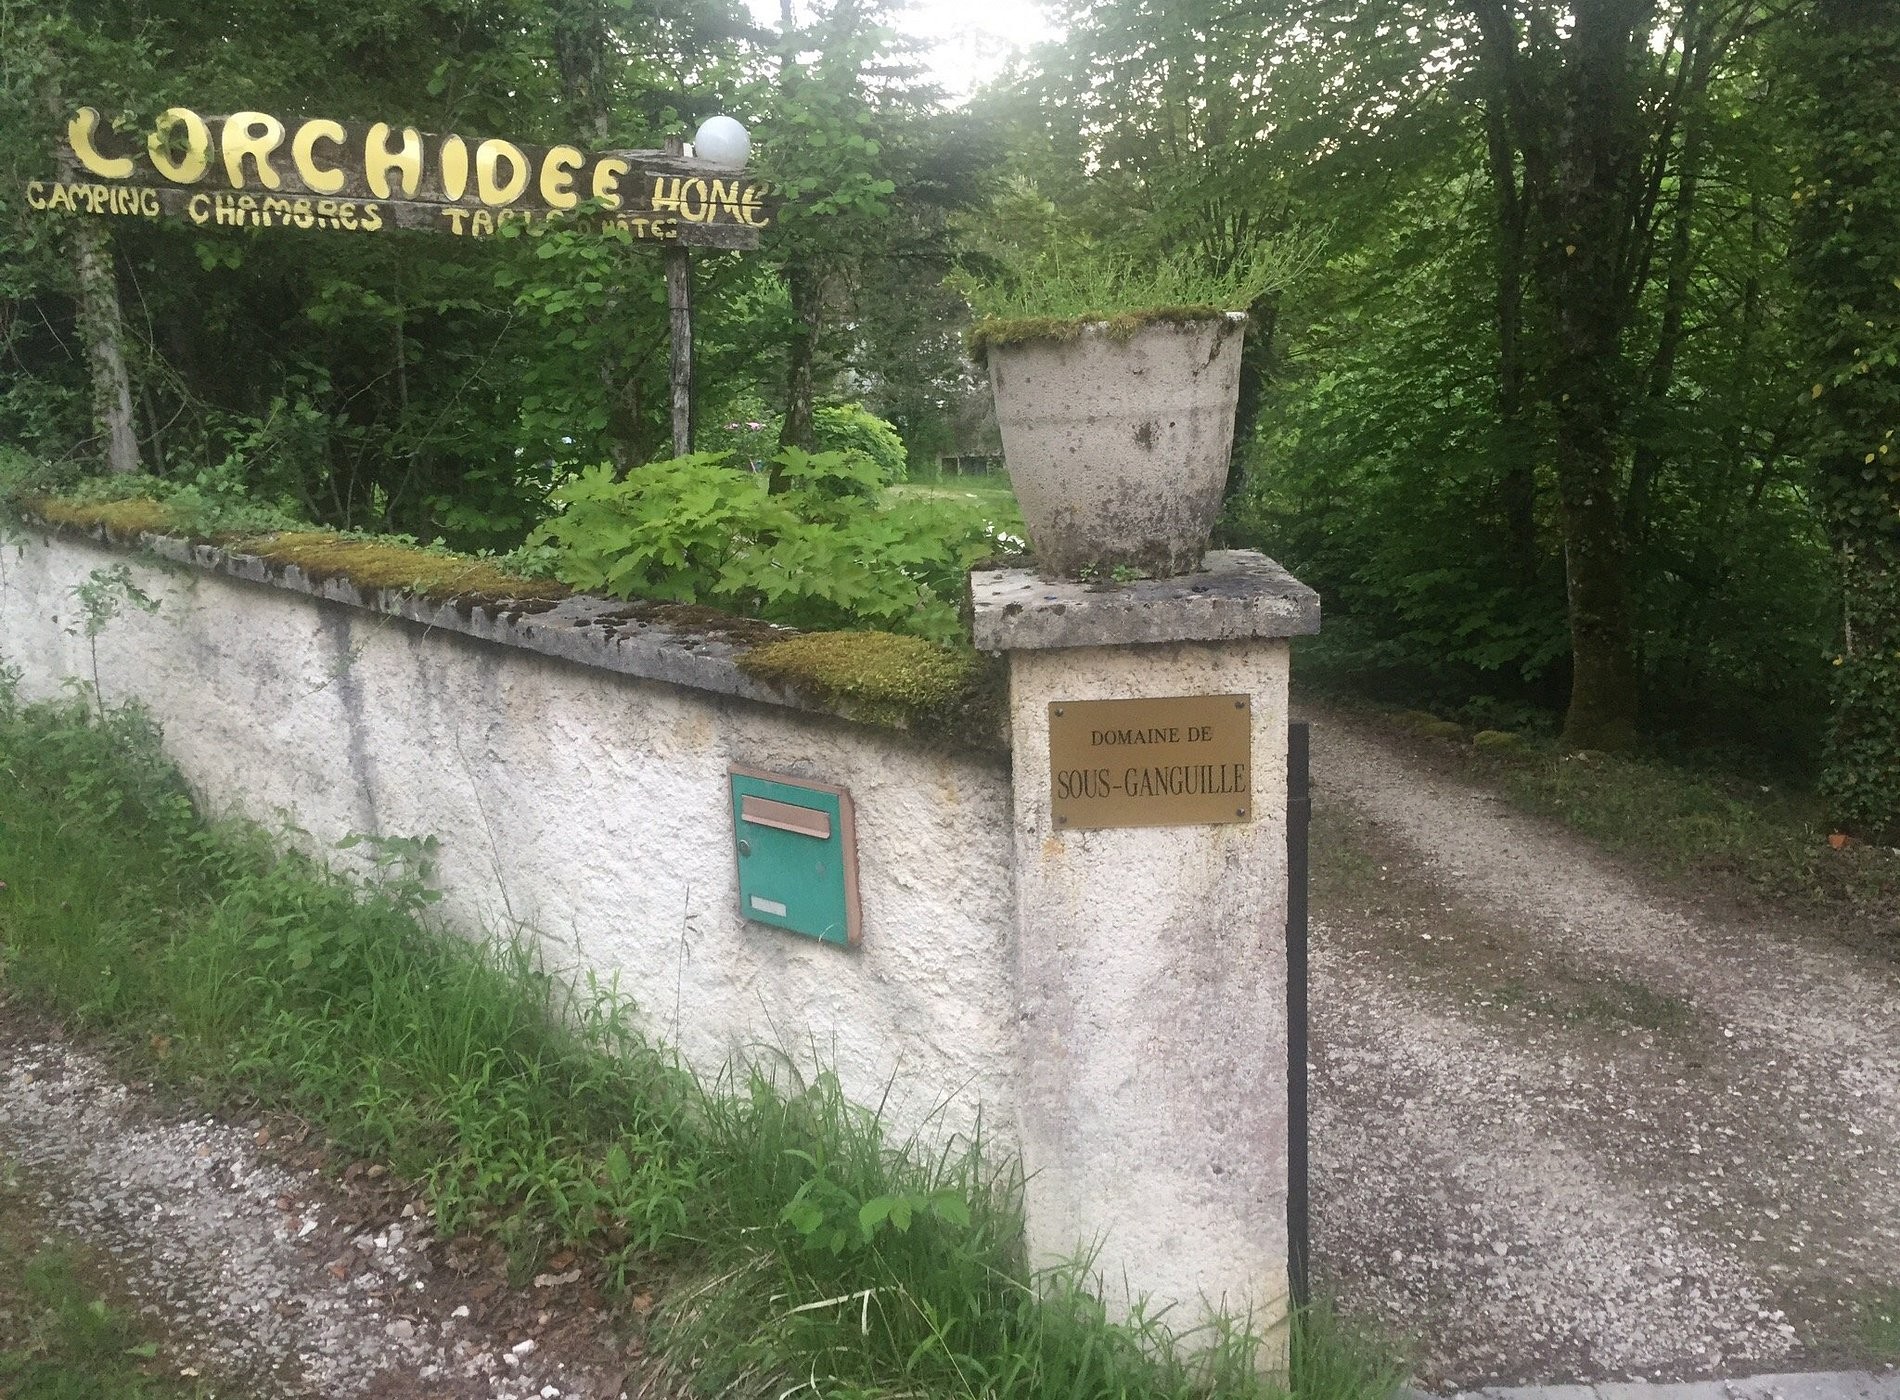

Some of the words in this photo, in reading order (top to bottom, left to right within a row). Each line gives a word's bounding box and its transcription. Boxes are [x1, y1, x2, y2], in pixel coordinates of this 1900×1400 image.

[26, 180, 160, 218] CAMPING
[188, 192, 384, 233] CHAMBRES
[651, 177, 770, 228] HOME
[1091, 728, 1180, 746] DOMAINE
[1187, 726, 1212, 742] DE
[1057, 763, 1246, 799] SOUS-GANGUILLE
